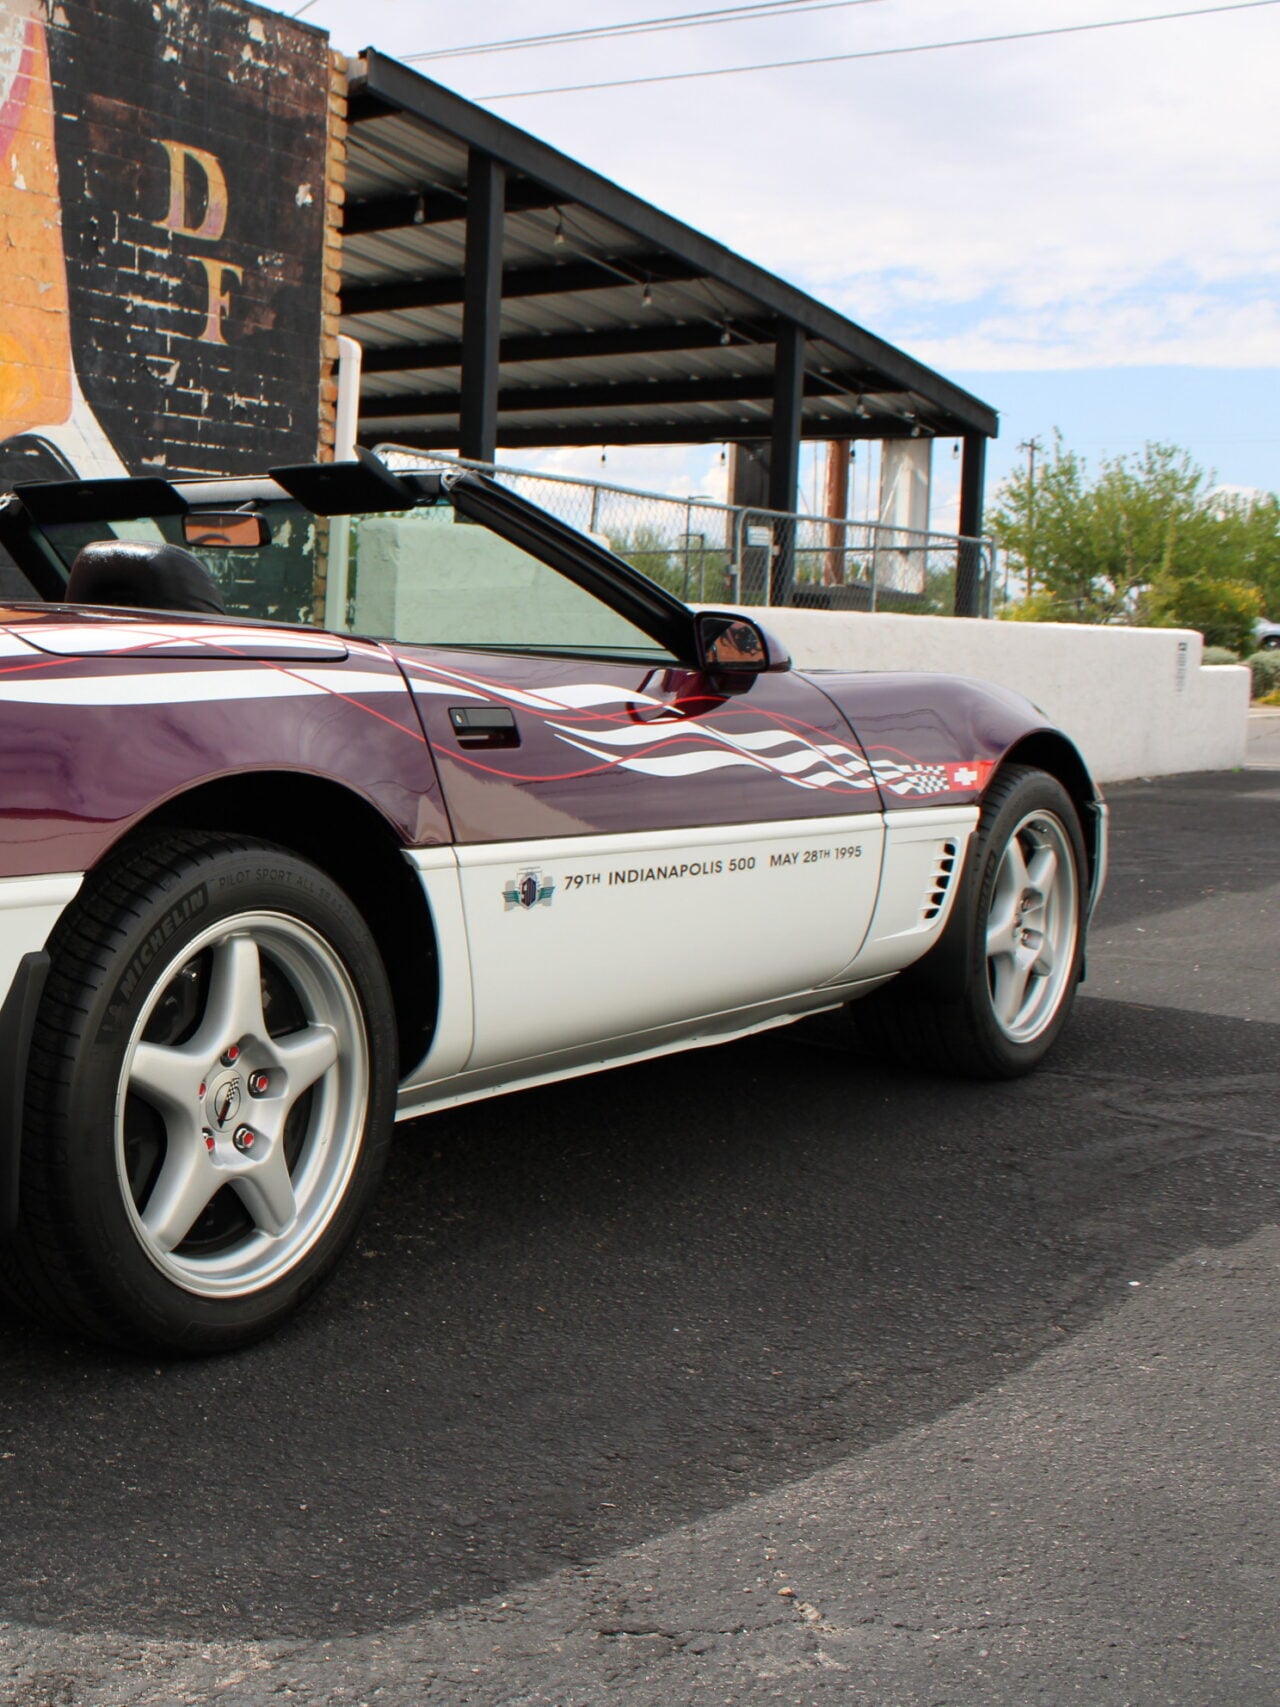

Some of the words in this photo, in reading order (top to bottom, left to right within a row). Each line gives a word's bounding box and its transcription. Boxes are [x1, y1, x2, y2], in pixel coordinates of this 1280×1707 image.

[152, 139, 228, 241] D
[190, 256, 244, 346] F
[219, 869, 250, 887] PILOT
[256, 868, 292, 882] SPORT
[564, 873, 601, 890] 79TH
[608, 860, 723, 885] INDIANAPOLIS
[728, 857, 756, 872] 500
[770, 852, 799, 867] MAY
[803, 850, 831, 864] 28TH
[834, 845, 862, 860] 1995
[120, 890, 204, 998] MICHELIN
